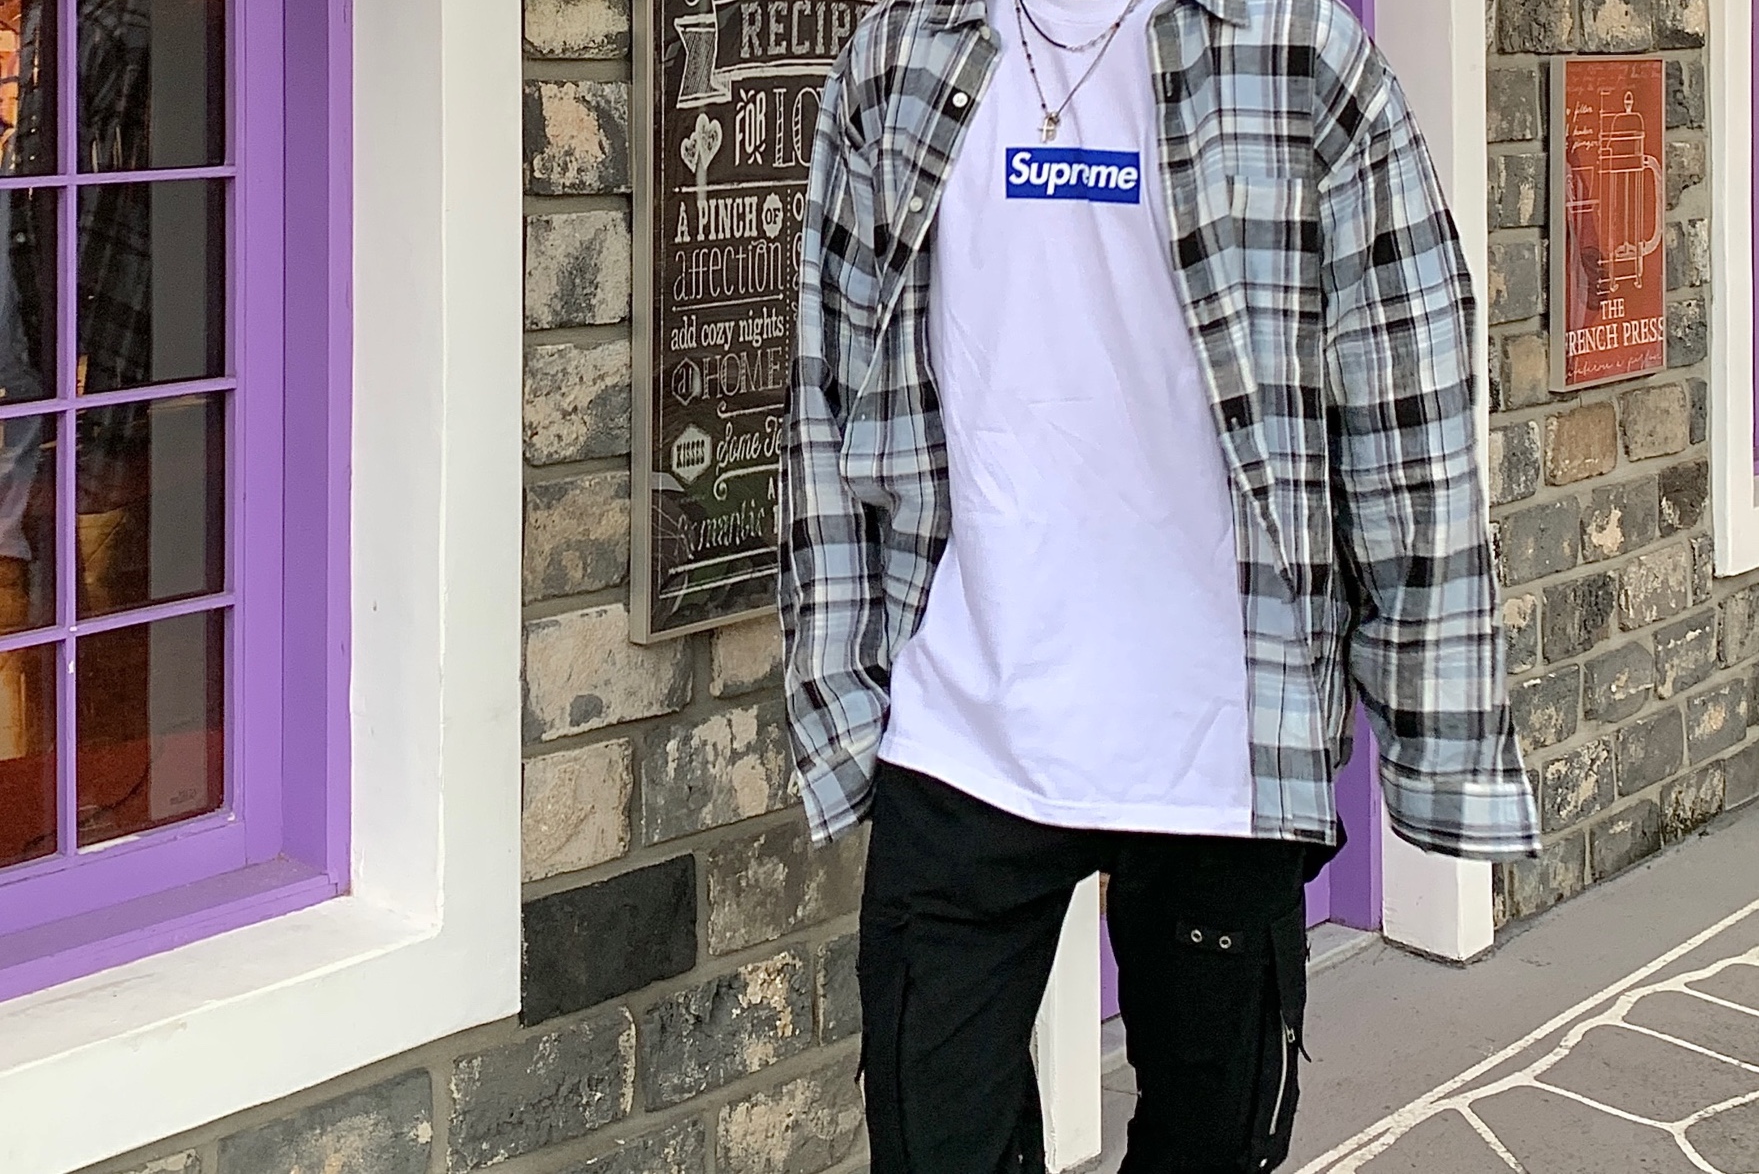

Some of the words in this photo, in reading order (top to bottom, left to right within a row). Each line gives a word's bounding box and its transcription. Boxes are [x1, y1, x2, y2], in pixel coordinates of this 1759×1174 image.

[740, 0, 872, 59] RECIP
[734, 90, 767, 167] FOR
[674, 201, 691, 244] A
[697, 196, 758, 242] PINCH
[764, 207, 781, 225] OF
[673, 239, 785, 301] affection
[670, 315, 697, 351] add
[701, 321, 735, 351] cozy
[738, 306, 785, 347] nights
[1600, 298, 1625, 320] THE
[1622, 316, 1664, 346] PRESS
[701, 346, 783, 400] HOME
[676, 438, 705, 469] KISSES
[716, 421, 763, 476] Some
